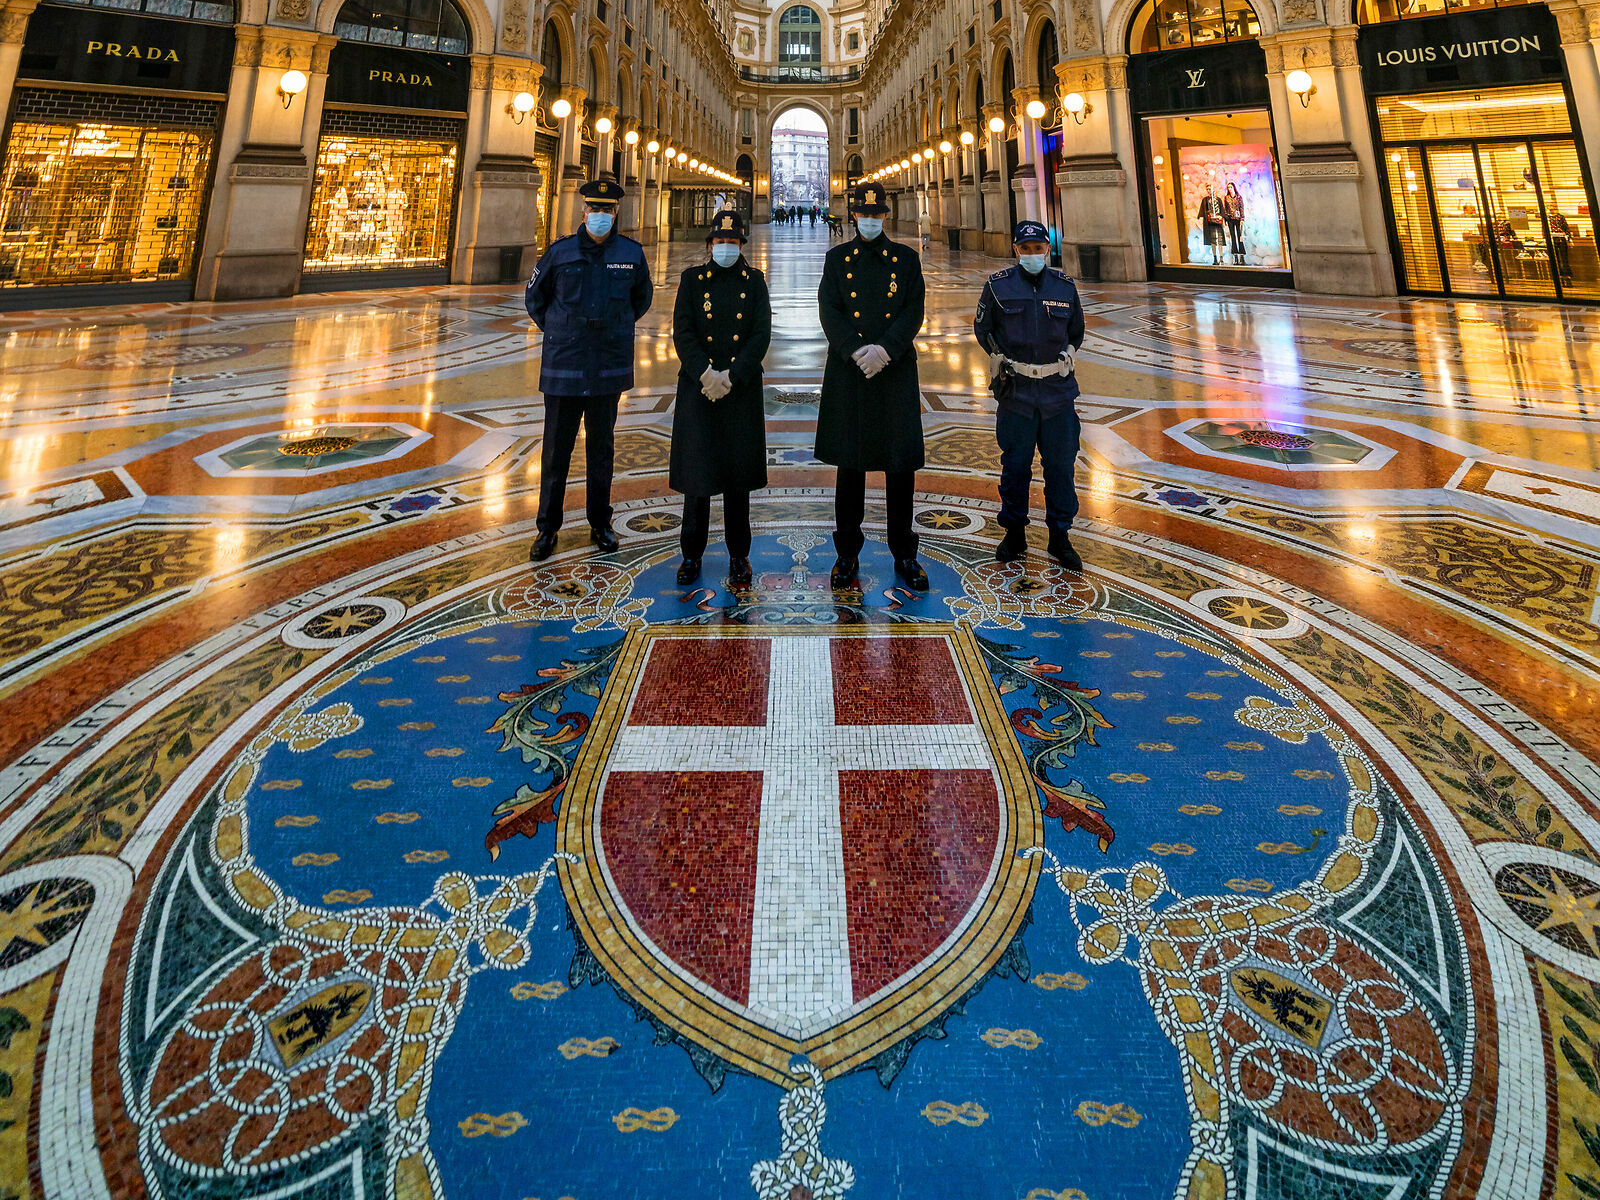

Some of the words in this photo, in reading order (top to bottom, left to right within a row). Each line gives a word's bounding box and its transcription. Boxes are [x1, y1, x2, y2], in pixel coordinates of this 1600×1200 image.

[86, 40, 180, 62] PRADA
[1377, 46, 1437, 66] LOUIS
[1440, 35, 1541, 60] VUITTON
[369, 70, 433, 86] PRADA
[1185, 68, 1206, 89] LV
[241, 588, 327, 629] FERT
[1260, 579, 1349, 614] FERT
[14, 698, 127, 767] FERT
[1456, 686, 1571, 753] FERT
